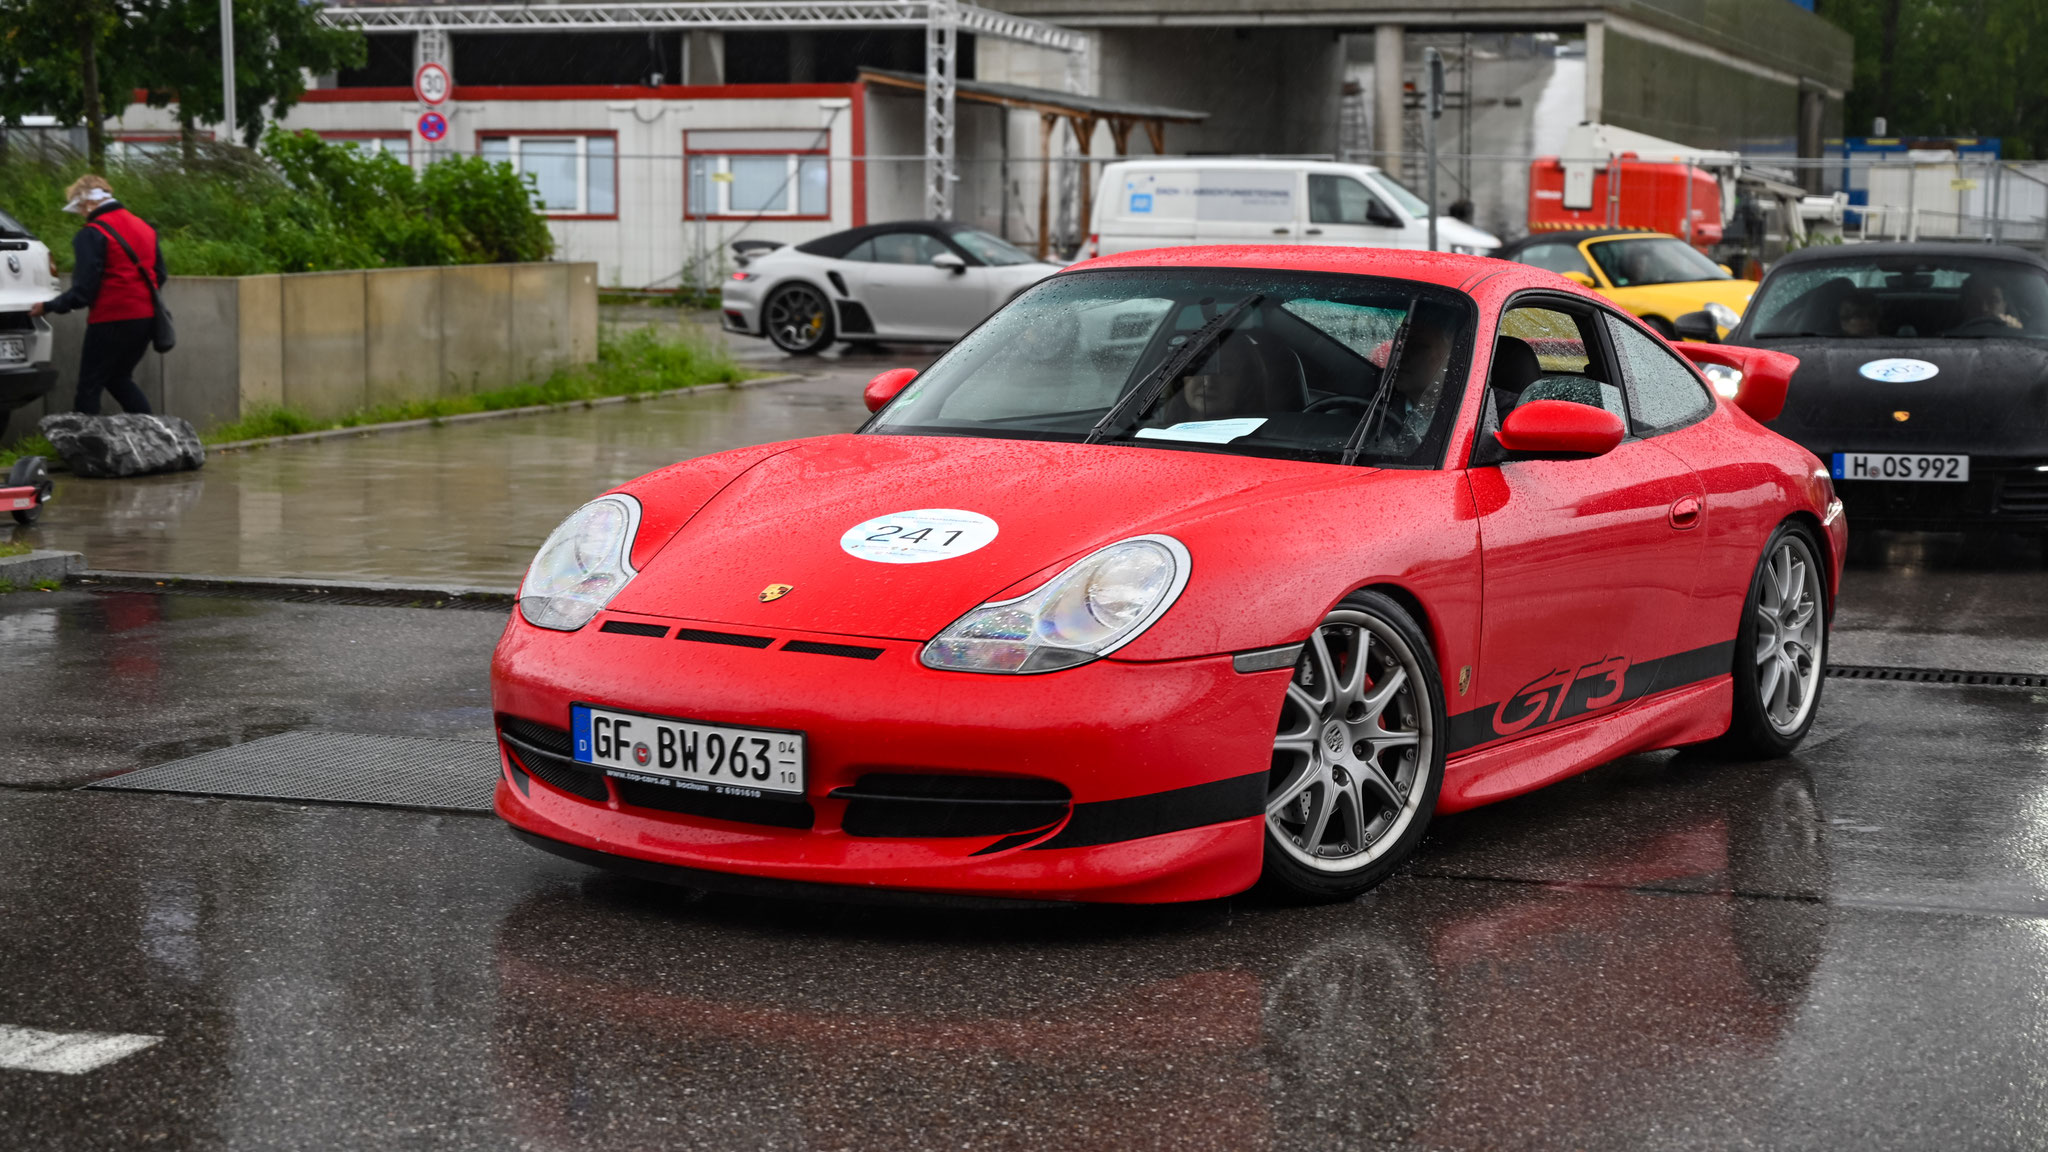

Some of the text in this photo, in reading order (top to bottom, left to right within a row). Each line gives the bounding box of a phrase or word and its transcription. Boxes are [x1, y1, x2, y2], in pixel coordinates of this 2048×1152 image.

[423, 74, 445, 93] 30
[1854, 456, 1959, 479] H OS 992
[865, 525, 964, 547] 241
[1492, 654, 1633, 736] GT3
[579, 739, 588, 752] D
[593, 716, 771, 781] GF BW 963
[778, 741, 796, 754] 04
[780, 771, 796, 784] 10
